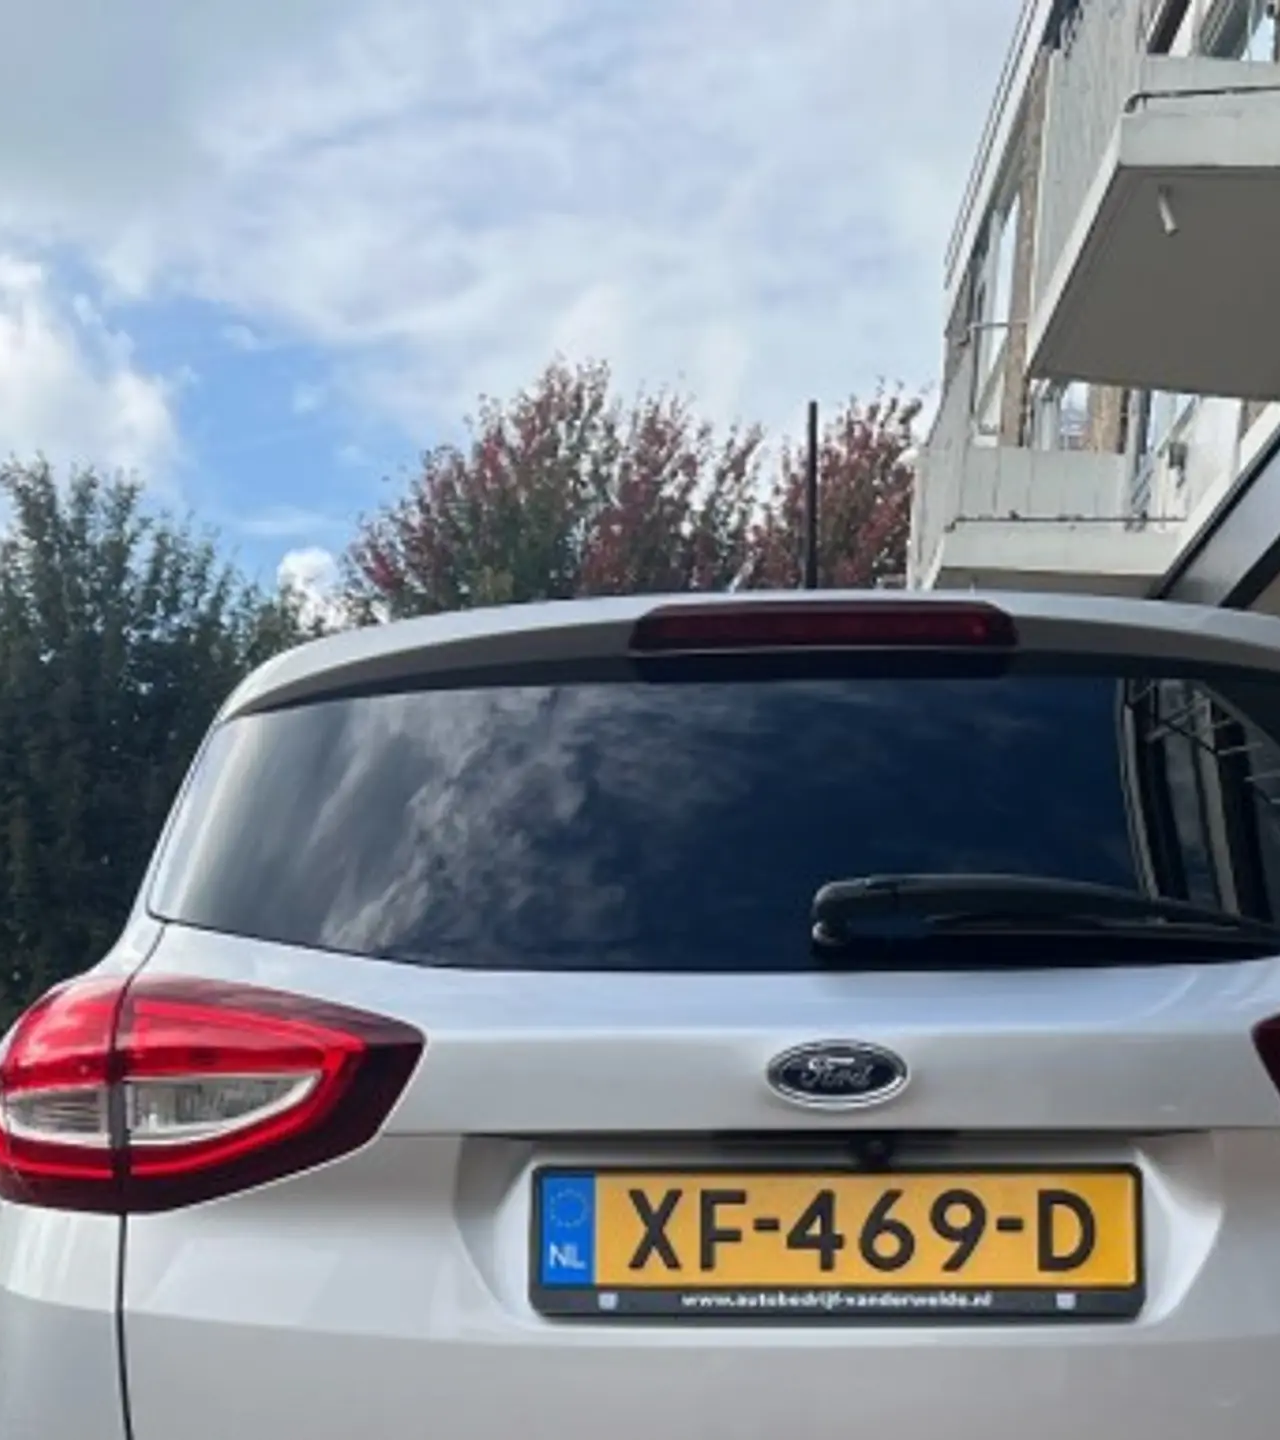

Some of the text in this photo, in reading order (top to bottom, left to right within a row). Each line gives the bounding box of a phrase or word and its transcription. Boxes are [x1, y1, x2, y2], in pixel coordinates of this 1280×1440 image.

[799, 1056, 874, 1088] Ford
[549, 1189, 1097, 1272] NL XF-469-D
